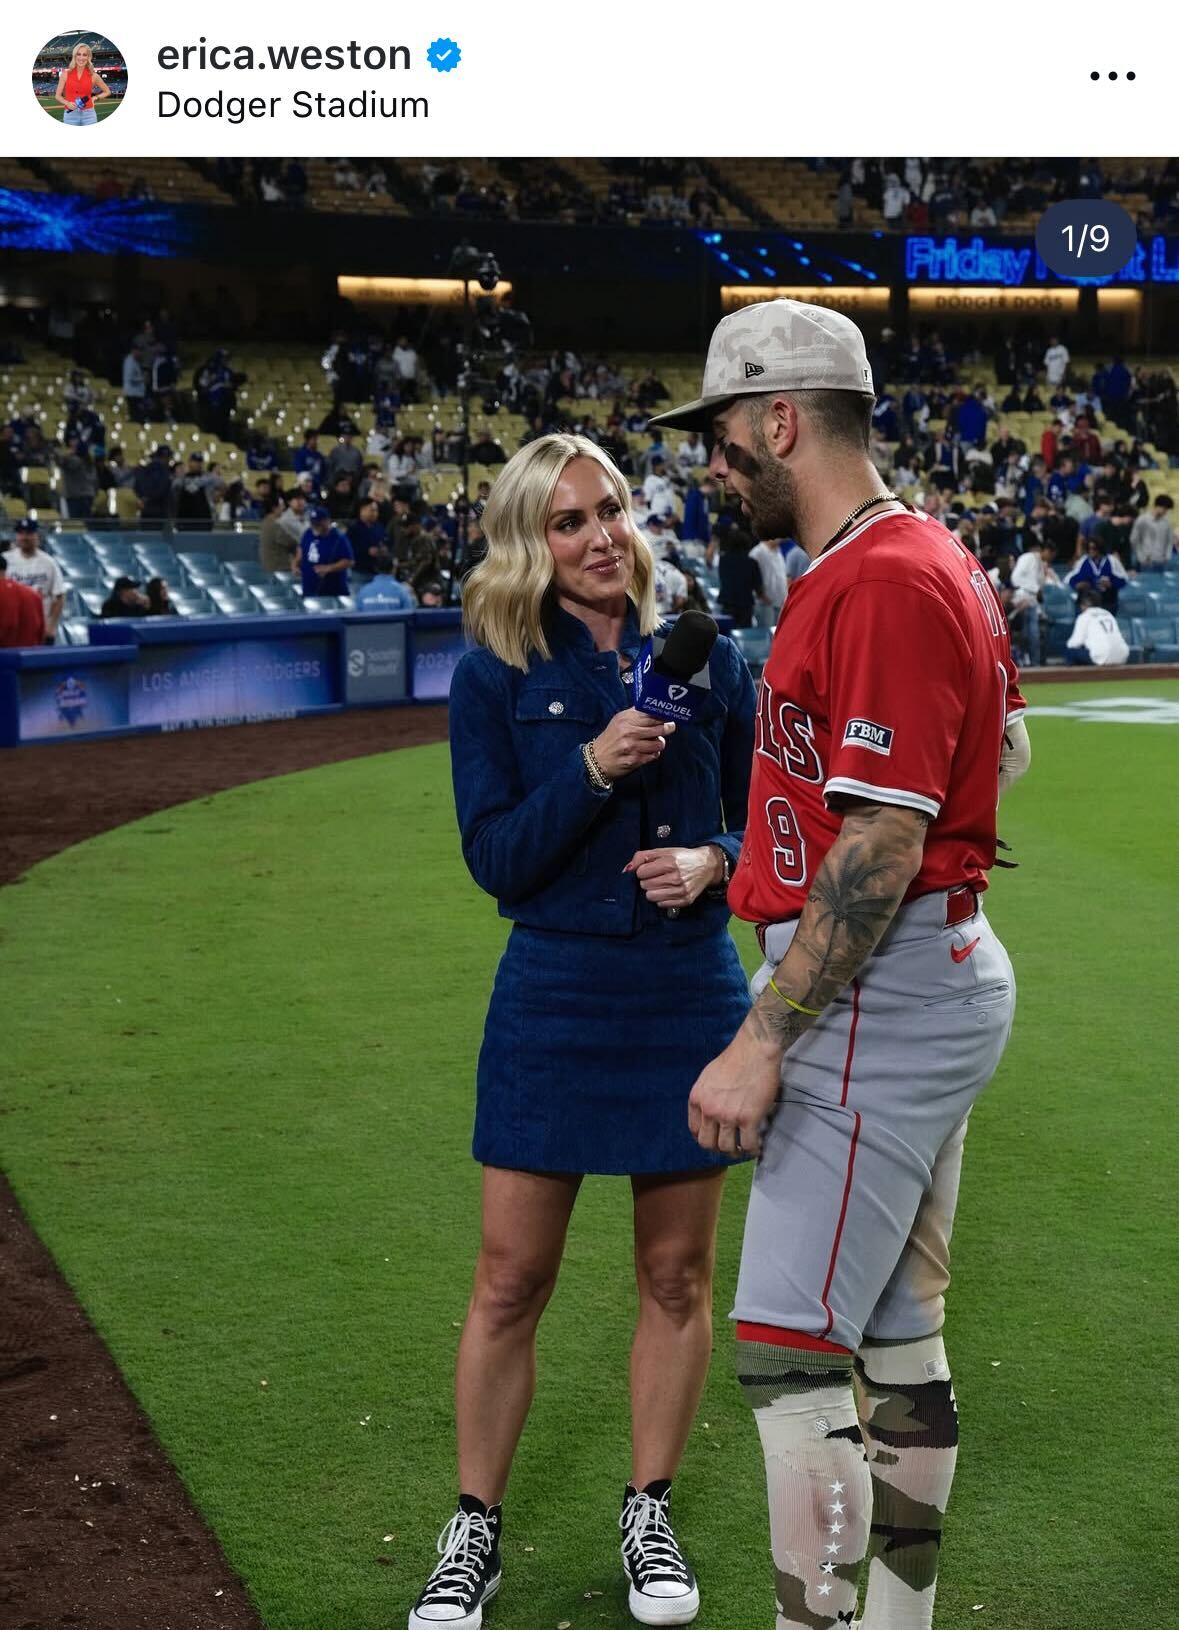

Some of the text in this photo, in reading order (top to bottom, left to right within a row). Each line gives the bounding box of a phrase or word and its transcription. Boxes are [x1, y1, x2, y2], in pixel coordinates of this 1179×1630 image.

[906, 236, 1031, 286] Friday
[935, 295, 1063, 310] DODGER DOGS
[142, 671, 172, 692] LOS
[644, 696, 692, 717] FANDUEL
[848, 721, 886, 745] FBM
[765, 796, 807, 888] 9
